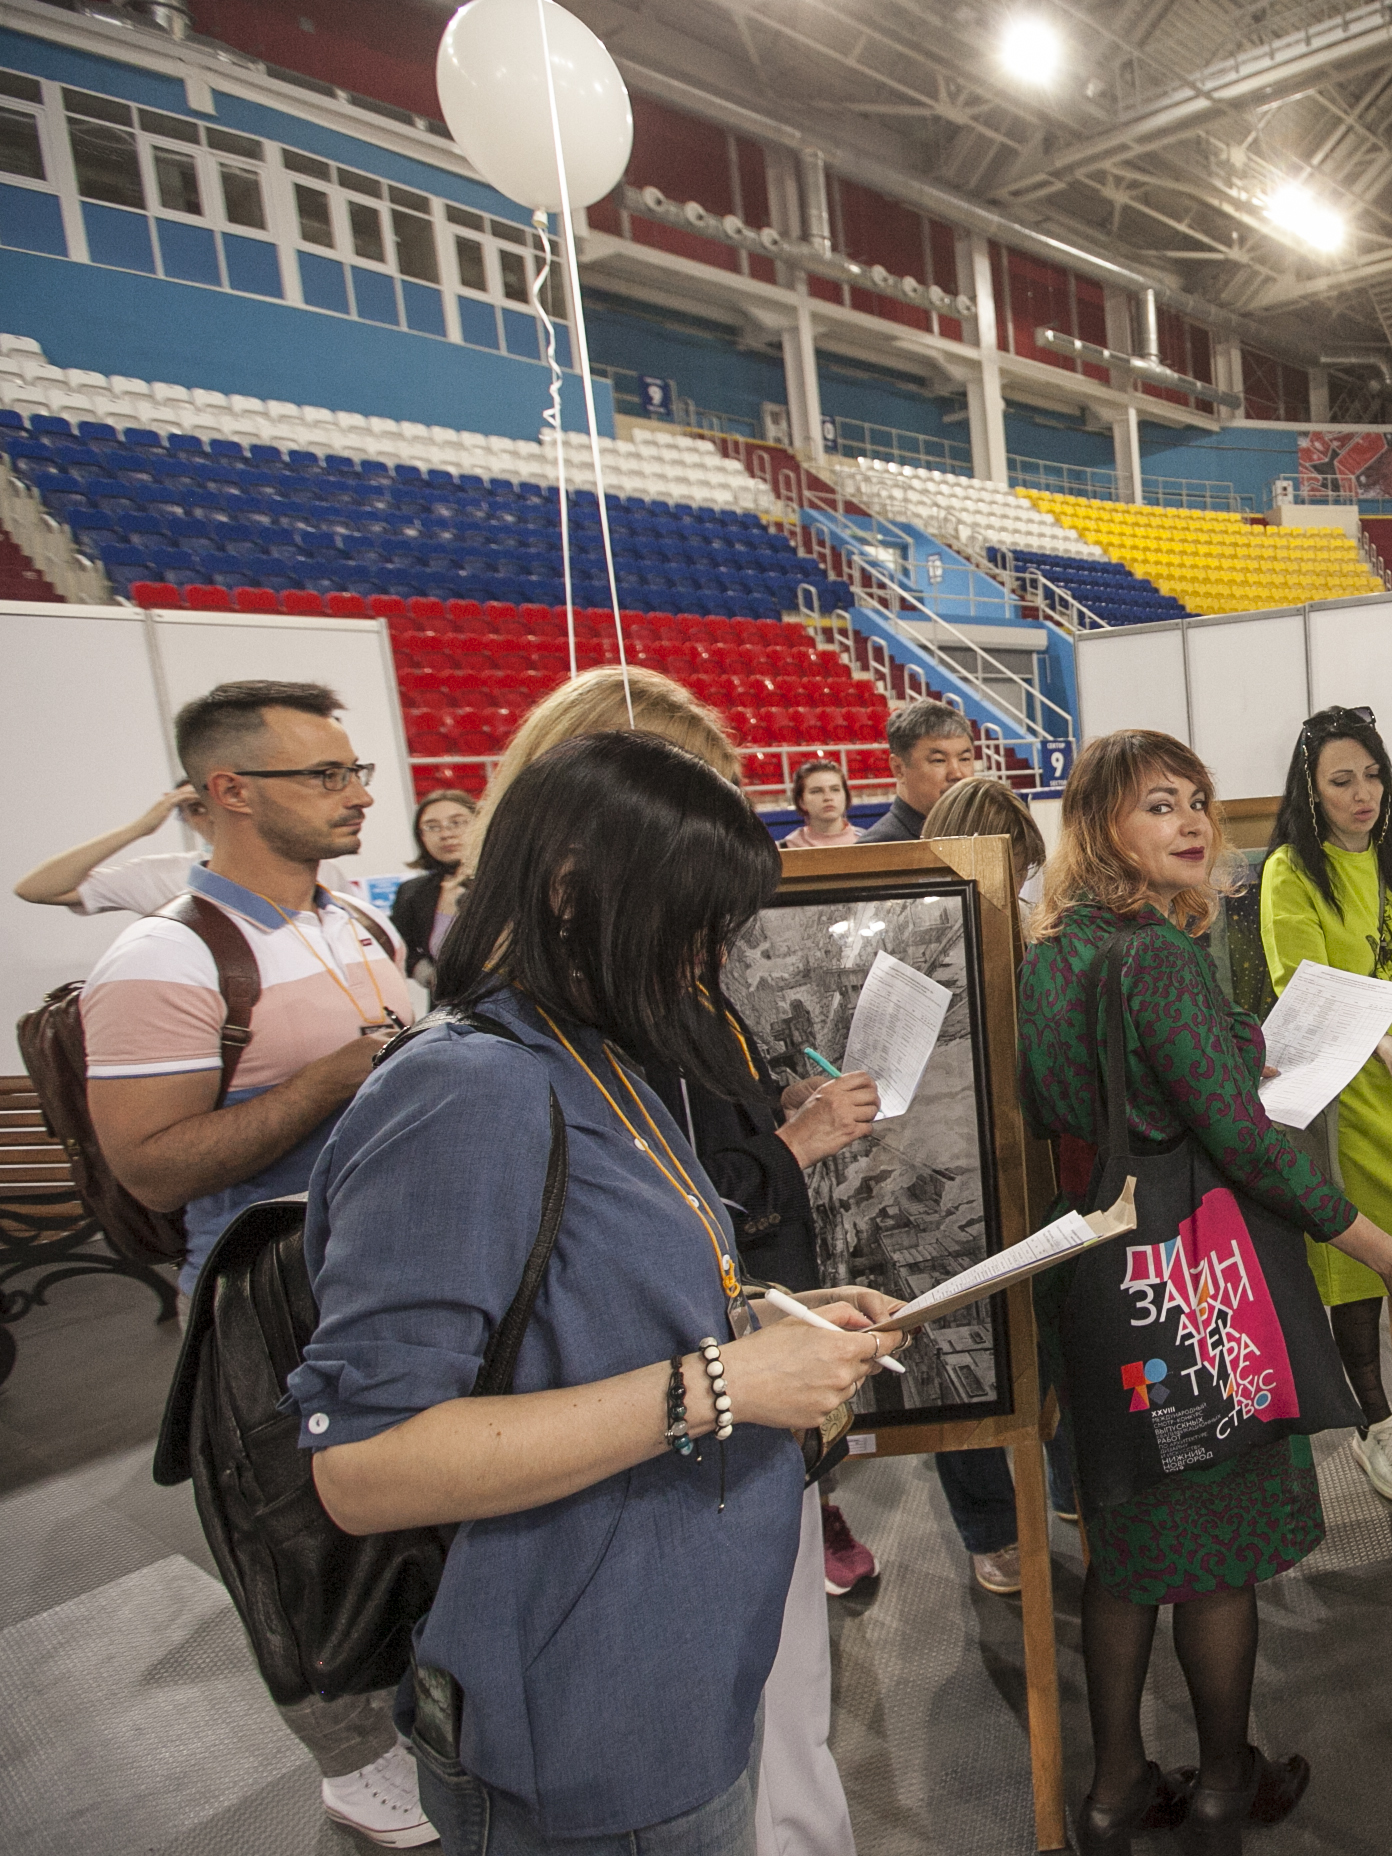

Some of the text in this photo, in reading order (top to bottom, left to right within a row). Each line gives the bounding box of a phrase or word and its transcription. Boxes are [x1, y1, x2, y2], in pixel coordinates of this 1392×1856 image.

[1050, 751, 1065, 778] 9
[1151, 1406, 1176, 1418] XXVIII
[1151, 1402, 1207, 1423] МЕЖДУНАРОДНЫЙ
[1153, 1411, 1204, 1428] СМОТР-КОНКУРС
[1154, 1416, 1204, 1435] ВЫПУСКНЫХ
[1157, 1434, 1182, 1444] РАБОТ
[1169, 1431, 1209, 1447] АРХИТЕКТУРЕ
[1161, 1447, 1206, 1464] НИЖНИЙ
[1163, 1451, 1214, 1470] НОВГОРОД
